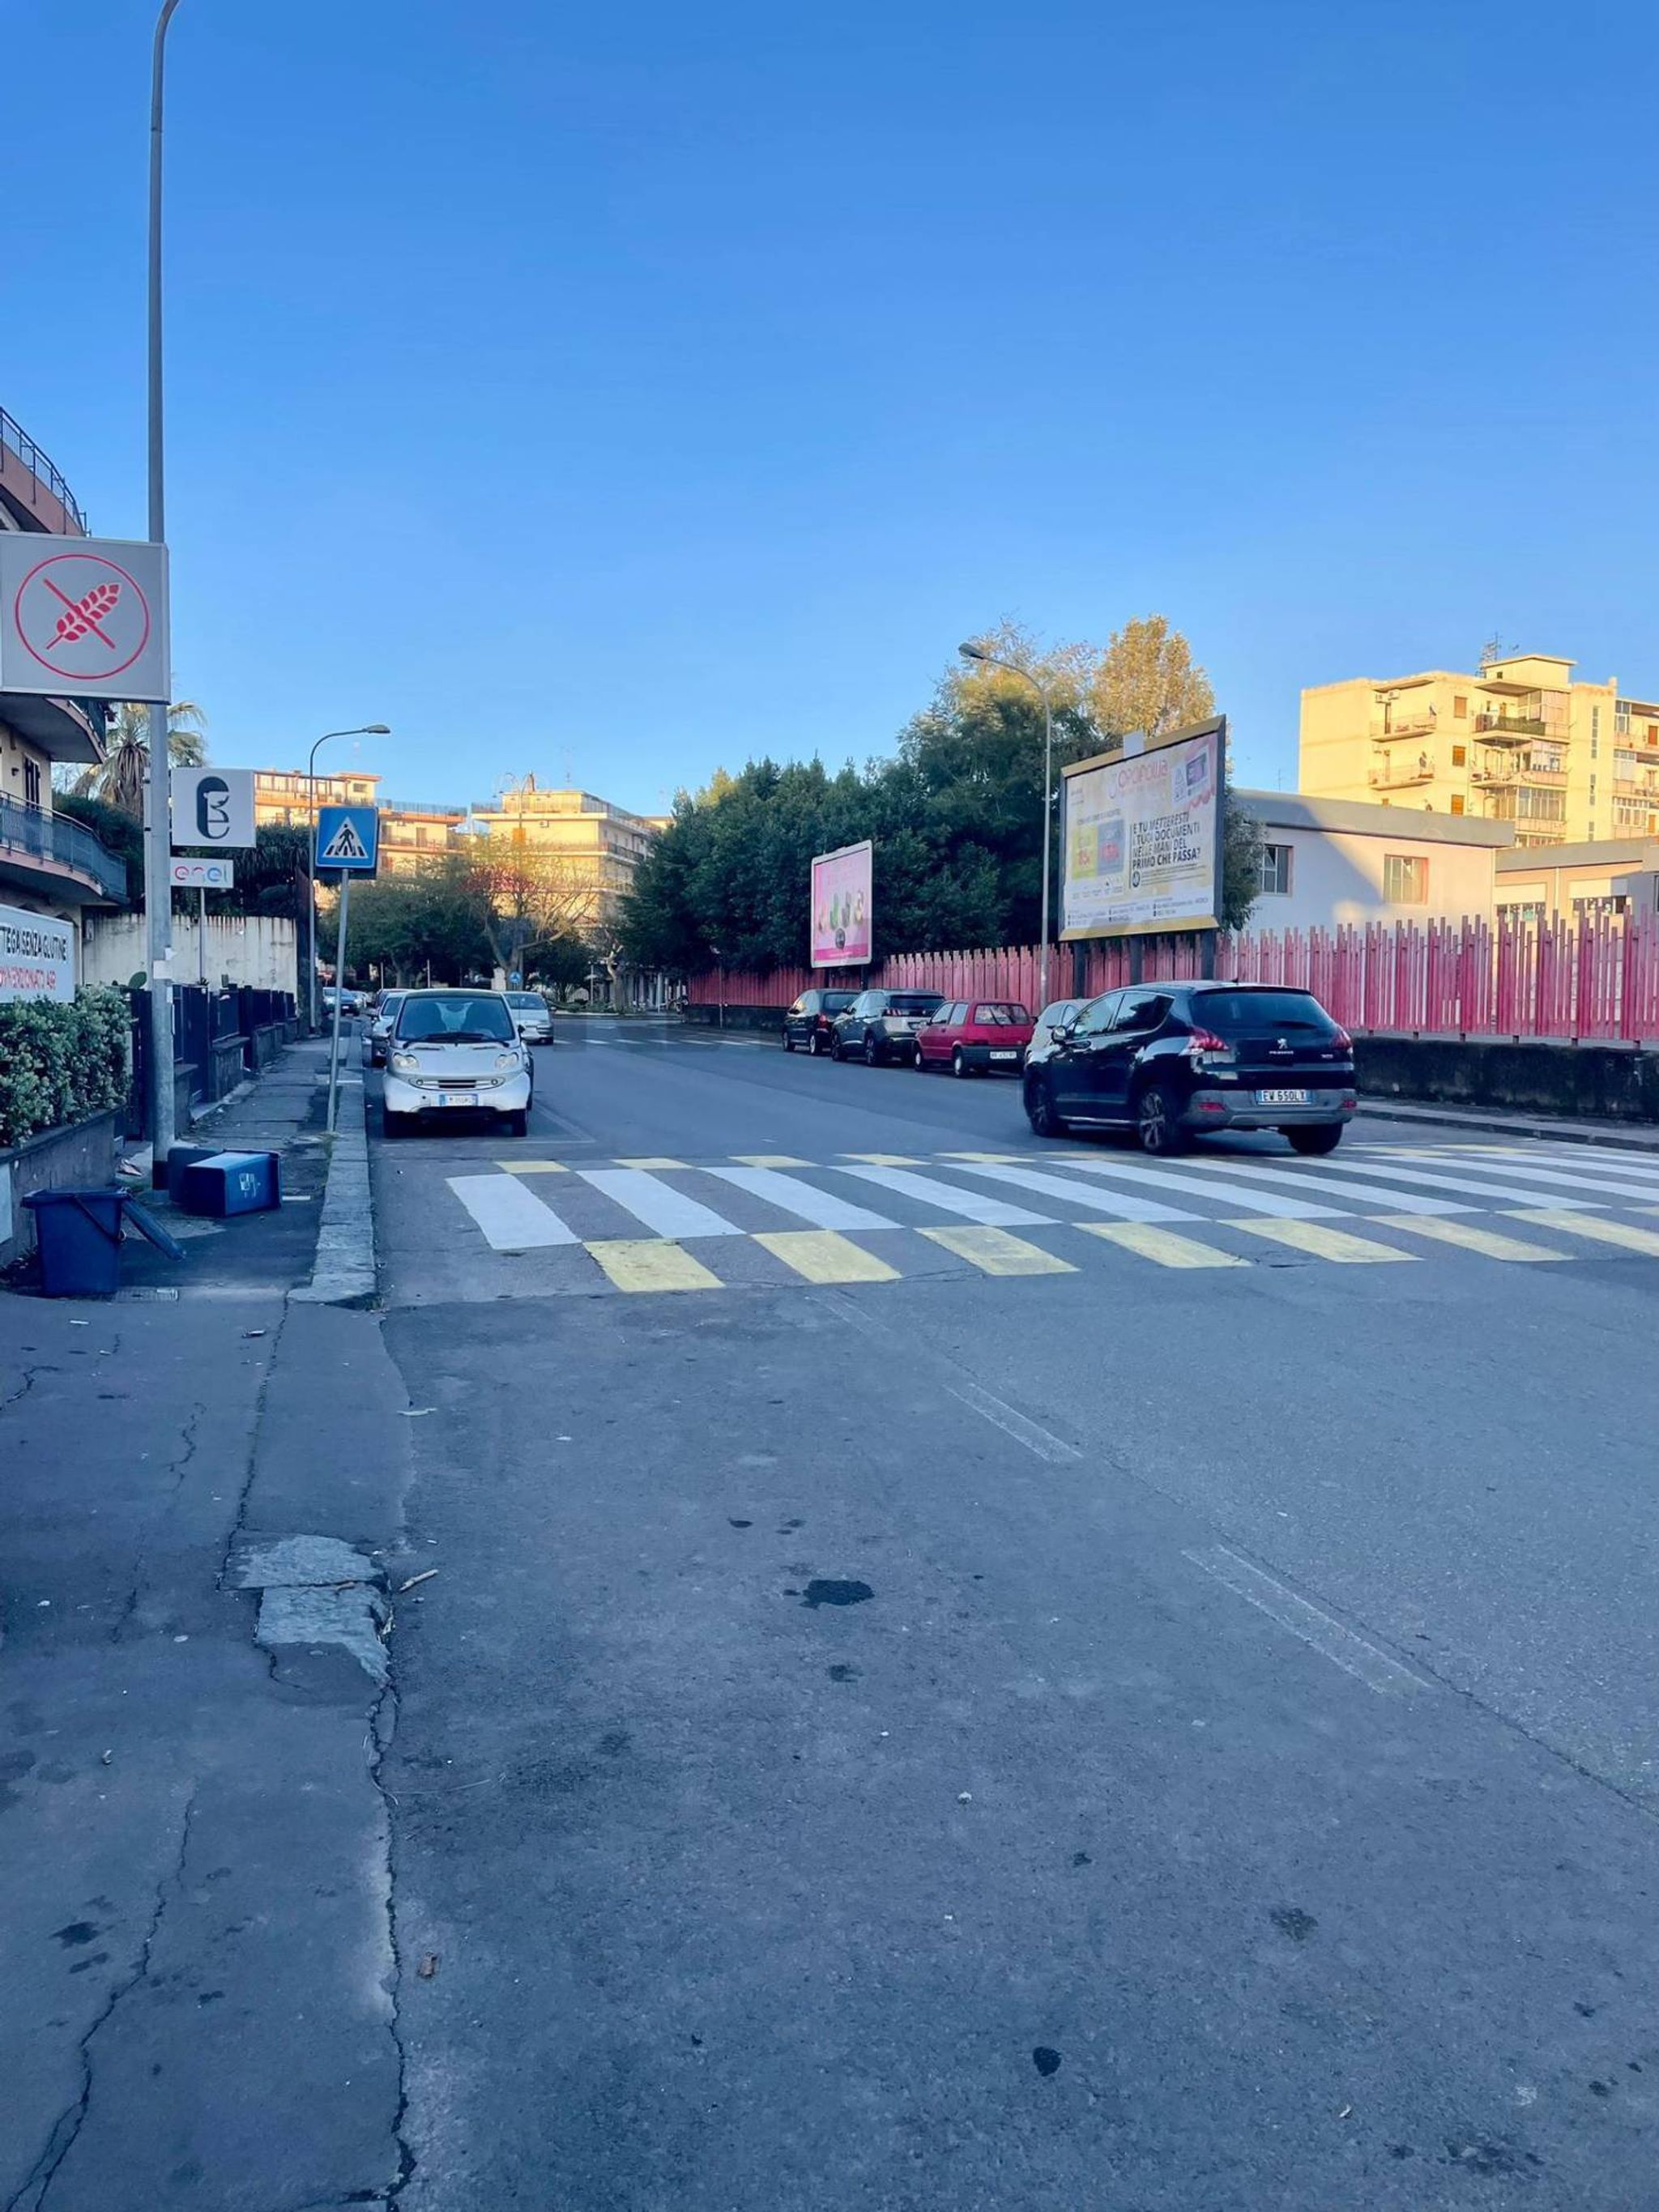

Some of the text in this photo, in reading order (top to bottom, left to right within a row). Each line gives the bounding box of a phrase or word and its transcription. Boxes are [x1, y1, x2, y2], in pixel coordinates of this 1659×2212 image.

[1139, 822, 1148, 833] TU
[1154, 822, 1200, 842] DOCUMENTI
[1173, 837, 1188, 850] DEL
[1132, 856, 1156, 870] PRIMO
[175, 864, 228, 883] enel
